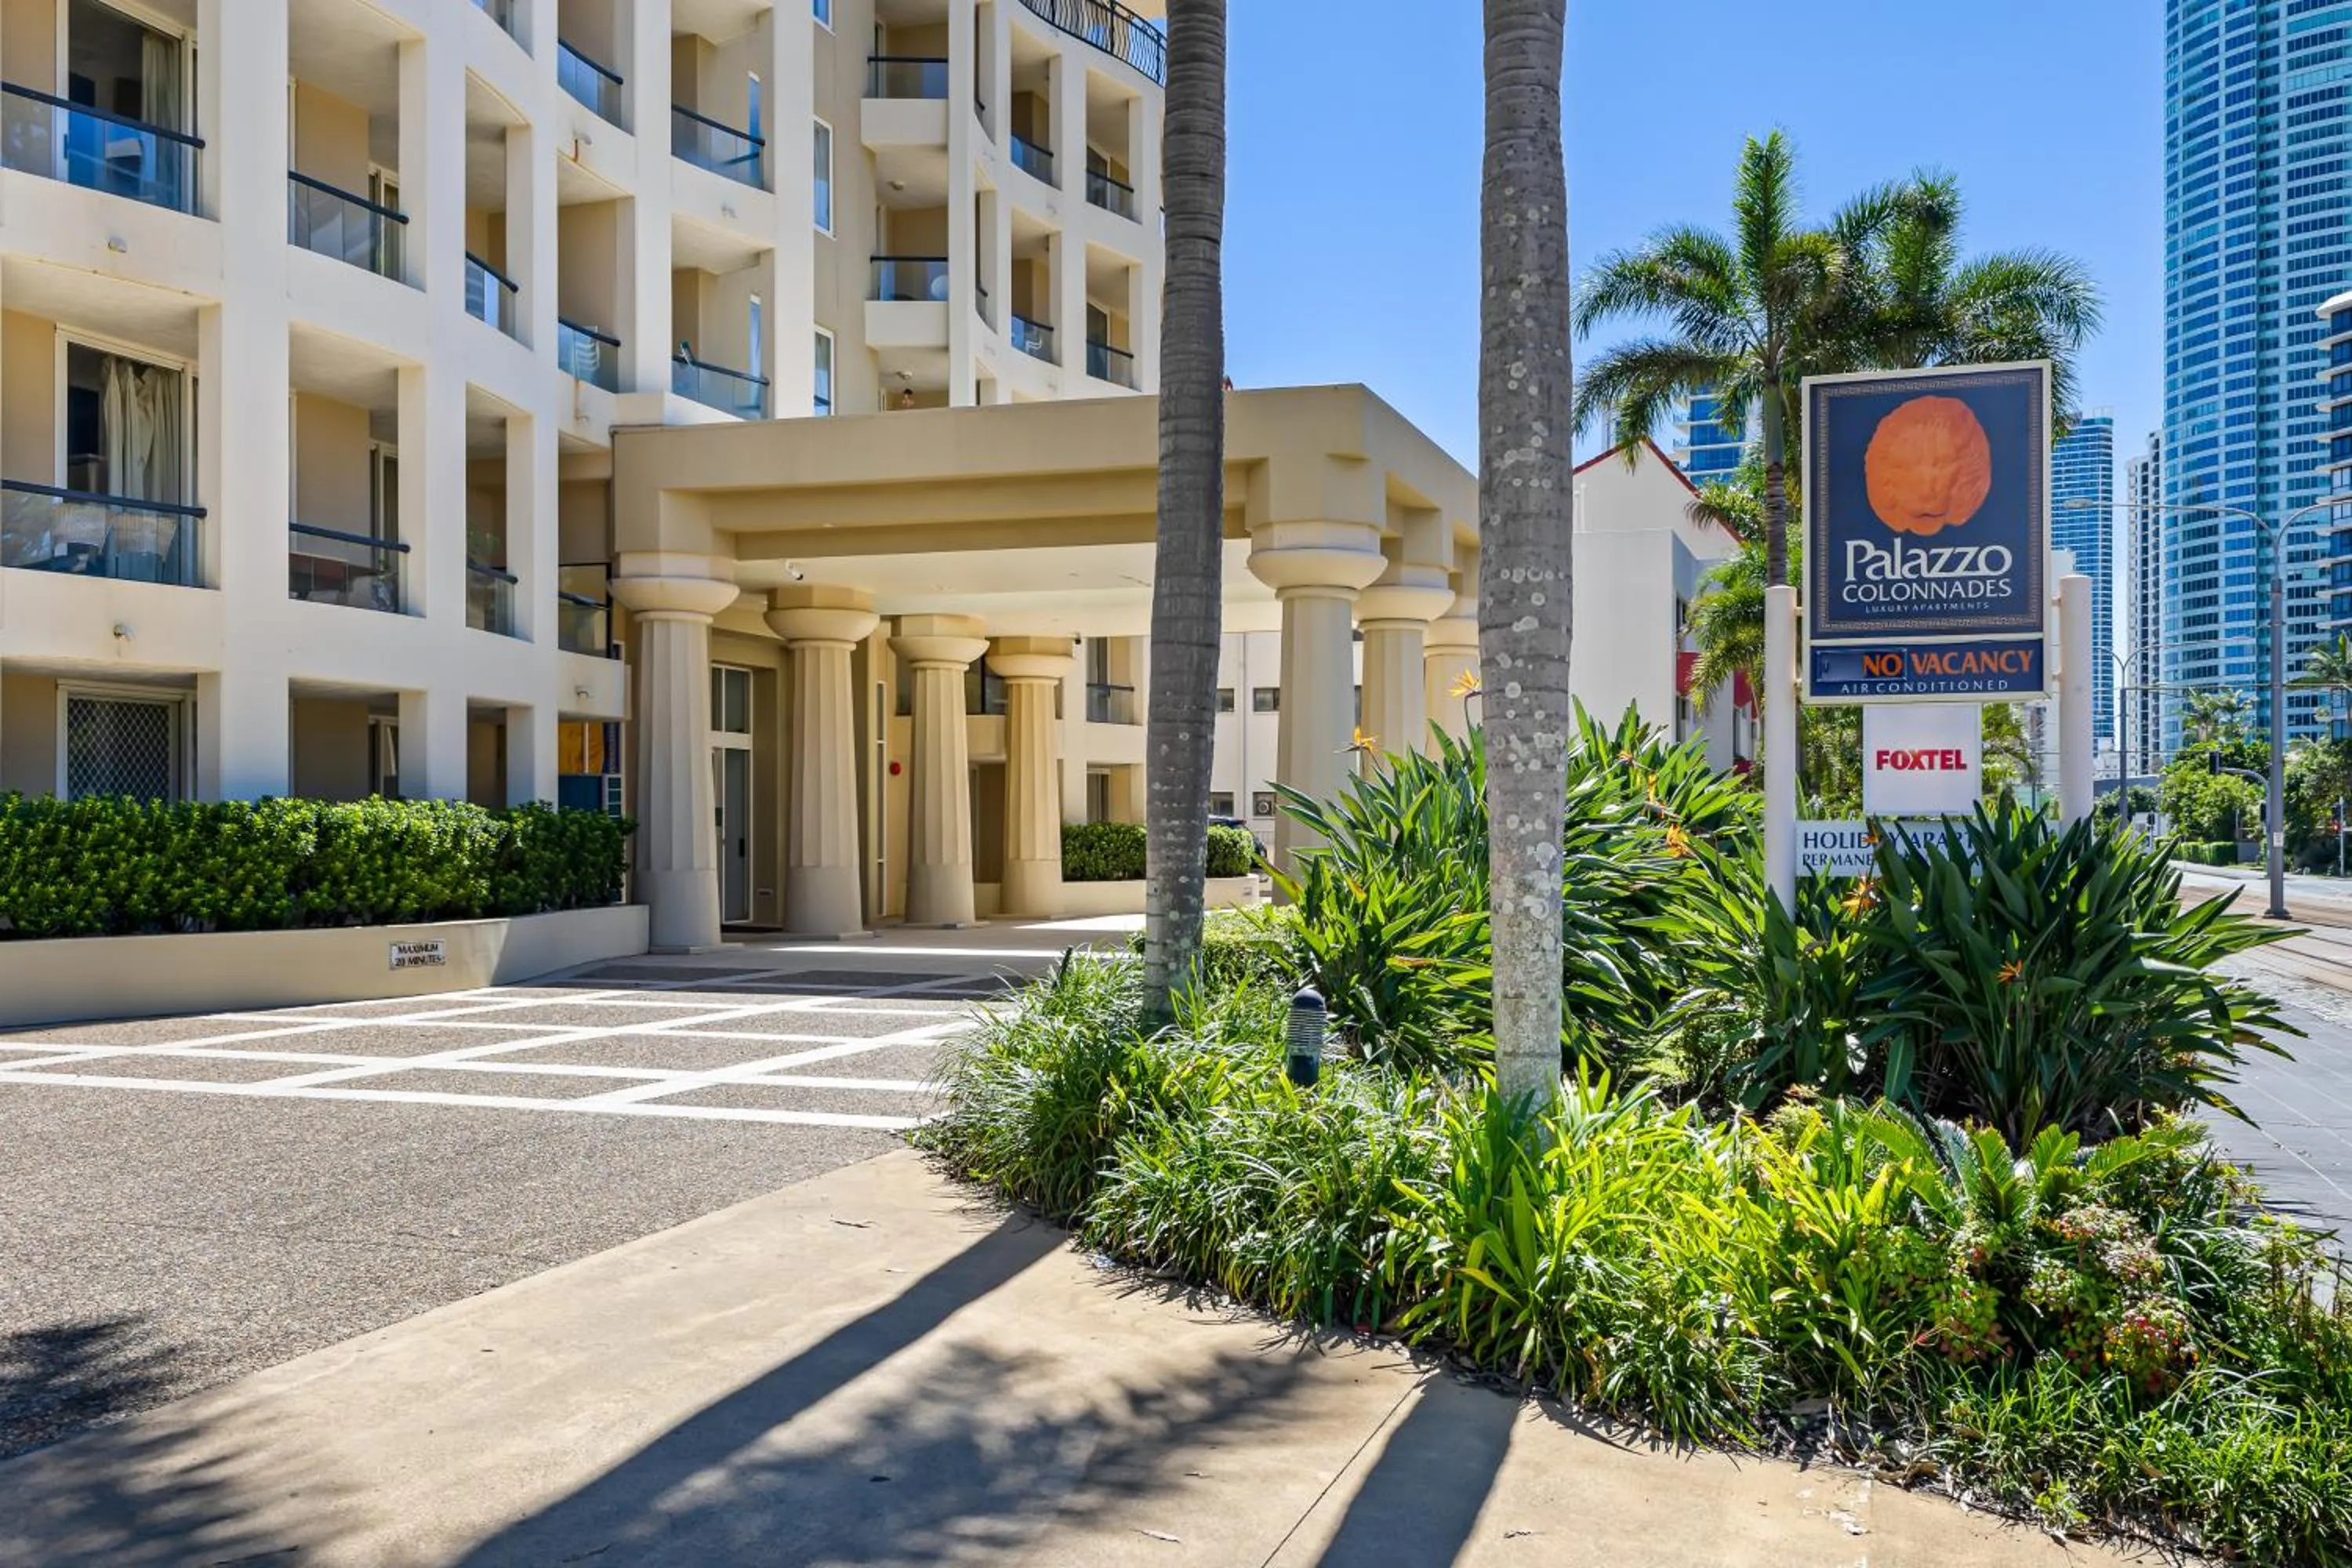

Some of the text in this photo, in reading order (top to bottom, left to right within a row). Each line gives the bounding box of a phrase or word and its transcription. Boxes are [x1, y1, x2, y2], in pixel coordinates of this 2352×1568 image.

[1845, 538, 2013, 582] Palazzo
[1842, 579, 2013, 603] COLONNADES
[1865, 601, 1989, 613] LUXURY APARTMENTS
[1863, 649, 2034, 677] NO VACANCY
[1842, 680, 2009, 693] AIR CONDITIONED
[1876, 750, 1967, 770] FOXTEL
[1804, 832, 1899, 848] HOLIDY
[397, 943, 438, 954] MAXIMUM
